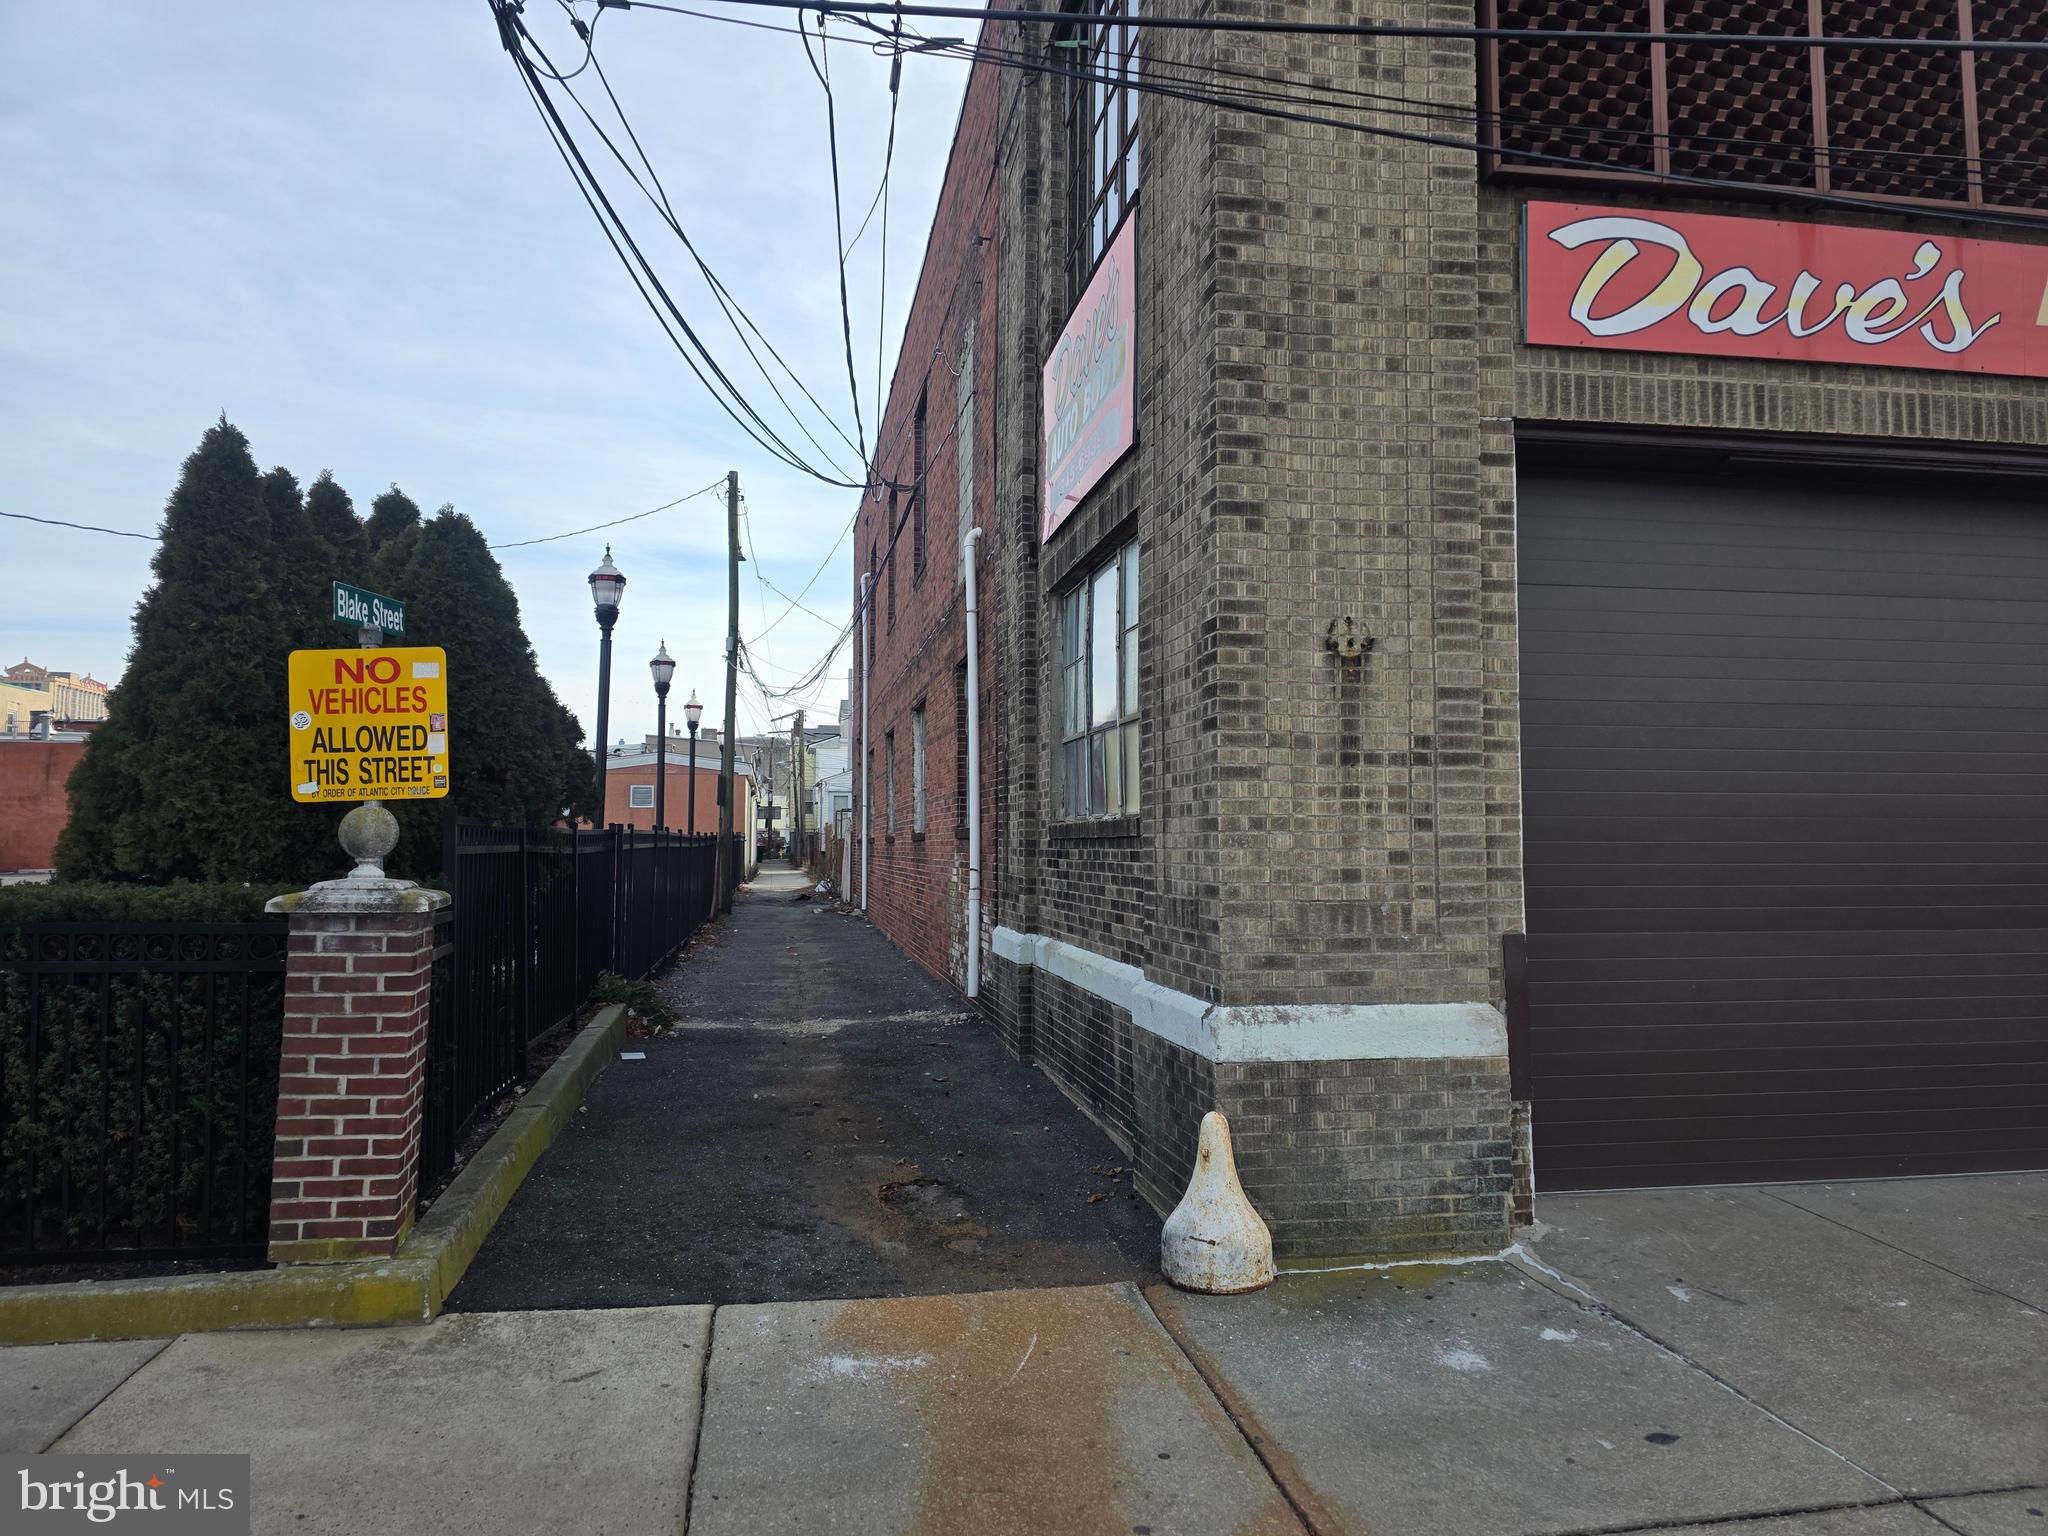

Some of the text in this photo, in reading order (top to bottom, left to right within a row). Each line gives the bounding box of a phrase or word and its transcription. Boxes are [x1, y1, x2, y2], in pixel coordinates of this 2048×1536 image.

[1547, 215, 2001, 354] Dave's
[1052, 255, 1119, 421] Dave's
[1050, 401, 1078, 471] AUTO
[337, 588, 404, 632] Blake Street
[334, 656, 401, 685] NO
[308, 685, 428, 715] VEHICLES
[311, 724, 429, 753] ALLOWED
[303, 757, 350, 786] THIS
[358, 755, 436, 785] STREET
[322, 787, 345, 798] ORDER
[347, 787, 357, 797] OF
[358, 786, 389, 797] ATLANTIC
[390, 785, 405, 796] CITY
[407, 785, 431, 796] POLICE
